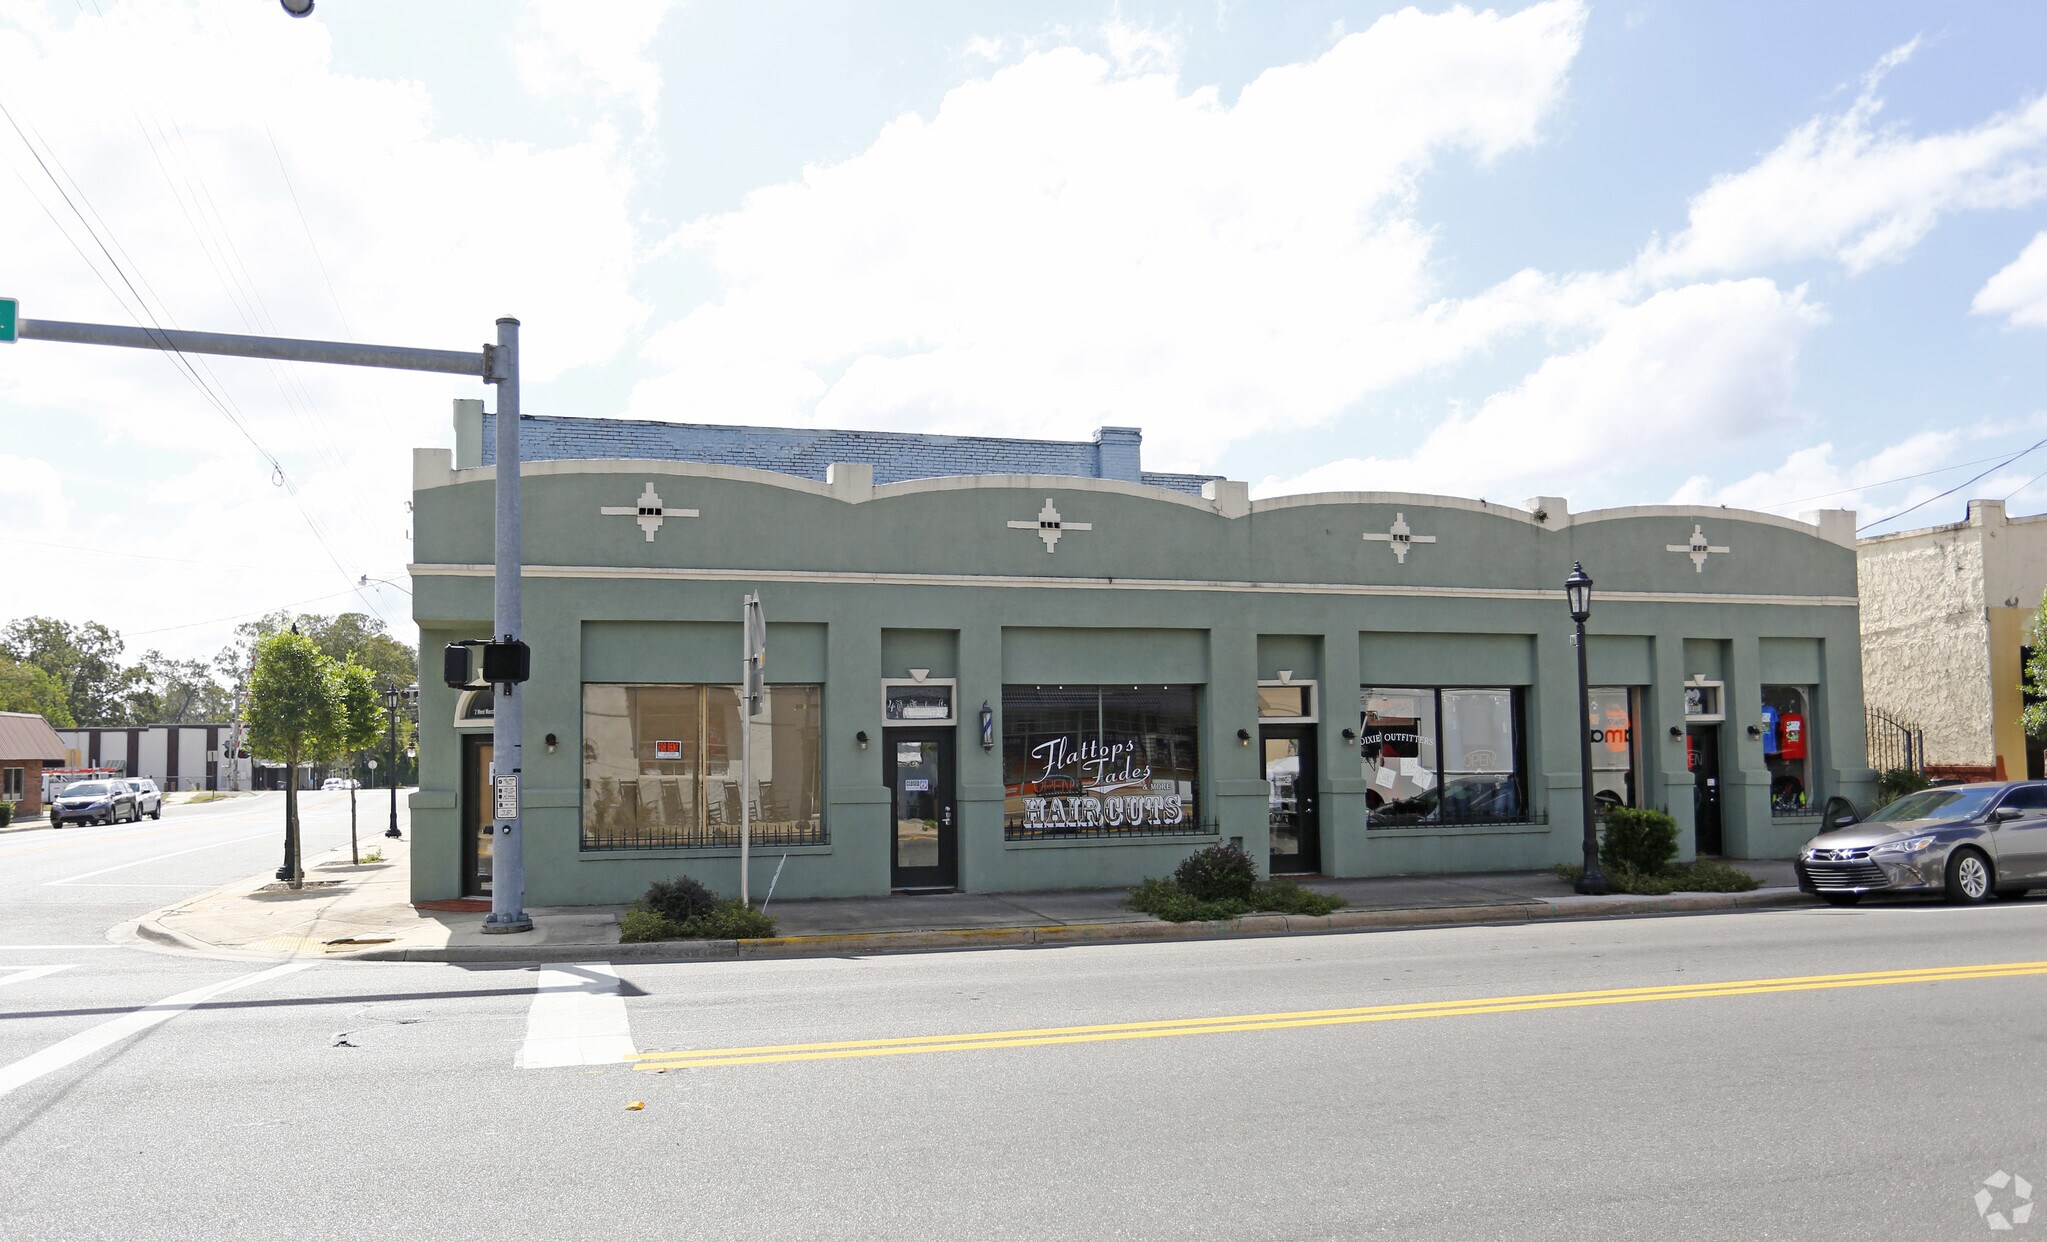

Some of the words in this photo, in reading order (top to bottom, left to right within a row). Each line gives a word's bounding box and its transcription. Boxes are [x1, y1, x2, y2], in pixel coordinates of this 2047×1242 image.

[1360, 734, 1381, 746] DIXIE
[1384, 733, 1434, 746] OUTFITTERS
[1031, 736, 1134, 784] Flattops
[1464, 753, 1495, 768] OPEN
[1082, 755, 1151, 788] Fades
[1033, 779, 1073, 793] OPEN
[1150, 783, 1172, 791] MORE
[1023, 794, 1183, 828] HAIRCUTS
